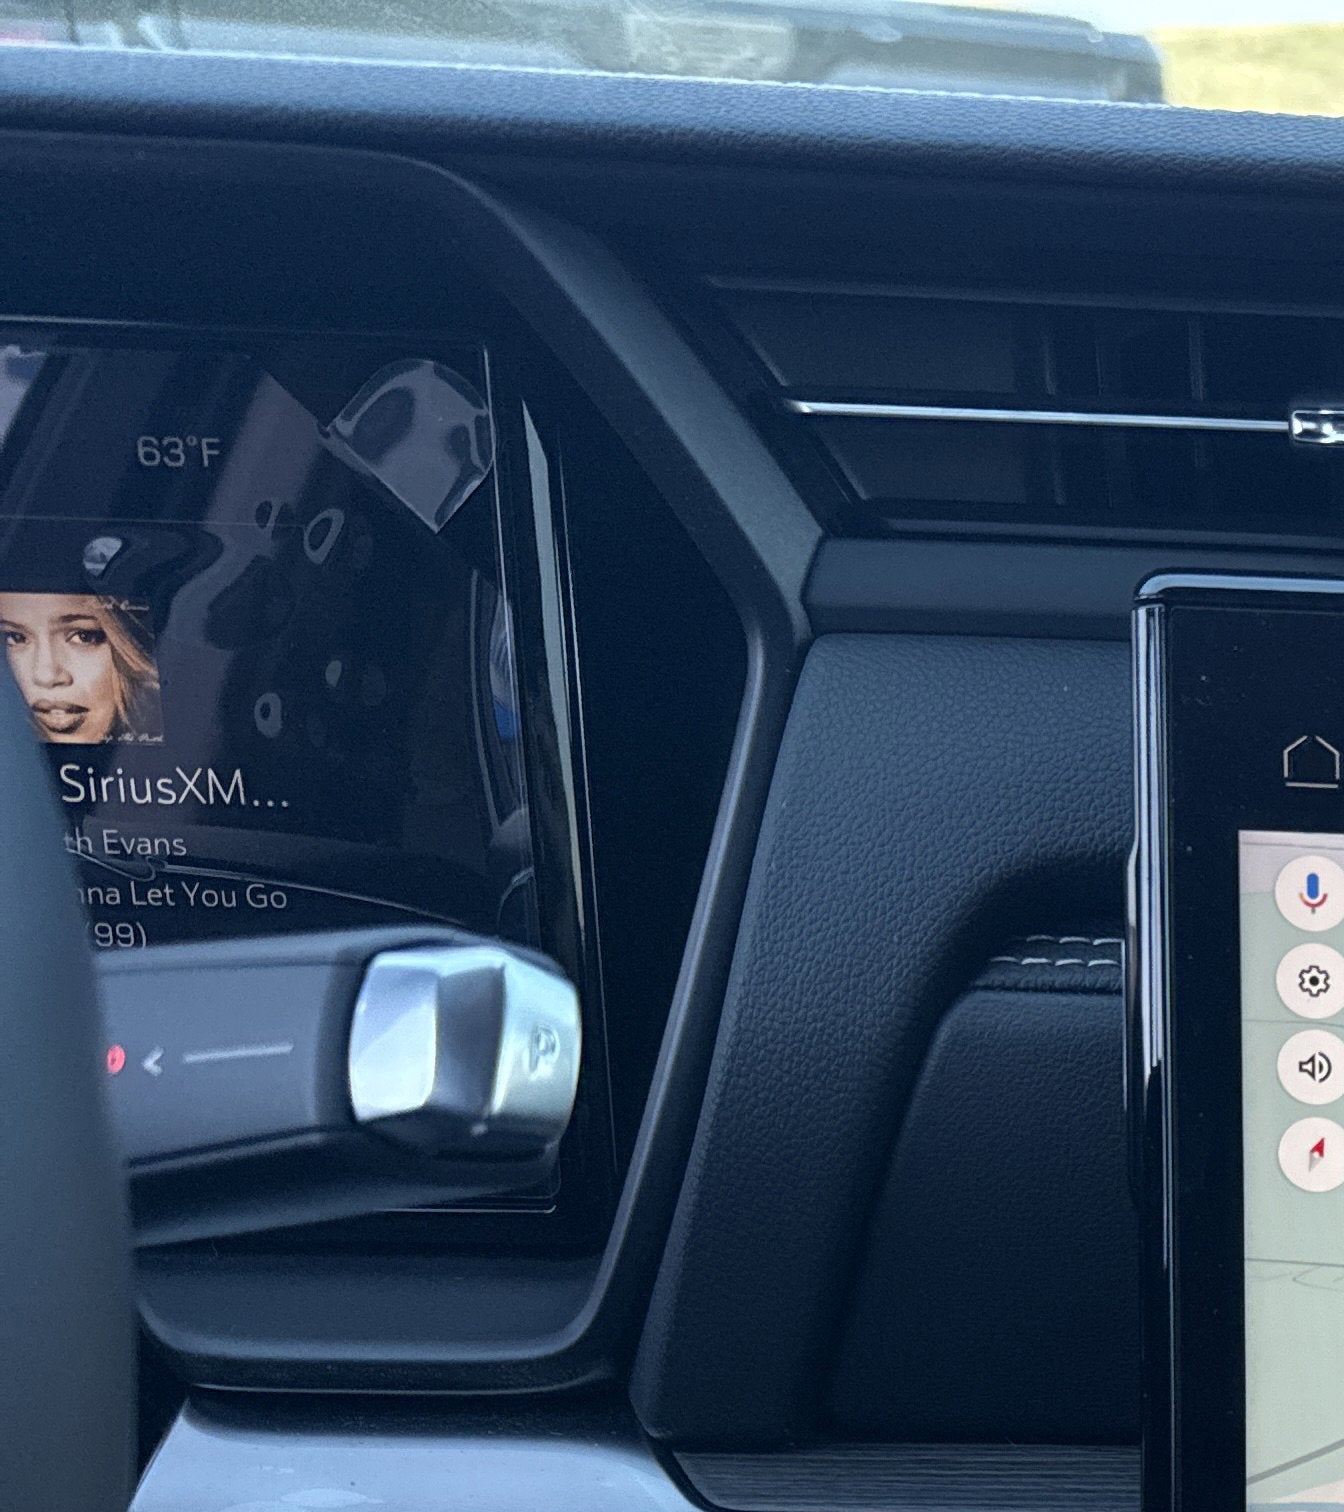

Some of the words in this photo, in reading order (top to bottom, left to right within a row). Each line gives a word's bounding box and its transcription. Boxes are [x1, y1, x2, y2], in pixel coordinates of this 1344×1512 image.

[137, 436, 221, 467] 63°F
[60, 764, 288, 805] SiriusXM...
[103, 829, 186, 856] Evans
[131, 881, 174, 906] Let
[182, 882, 236, 908] You
[247, 884, 287, 908] Go
